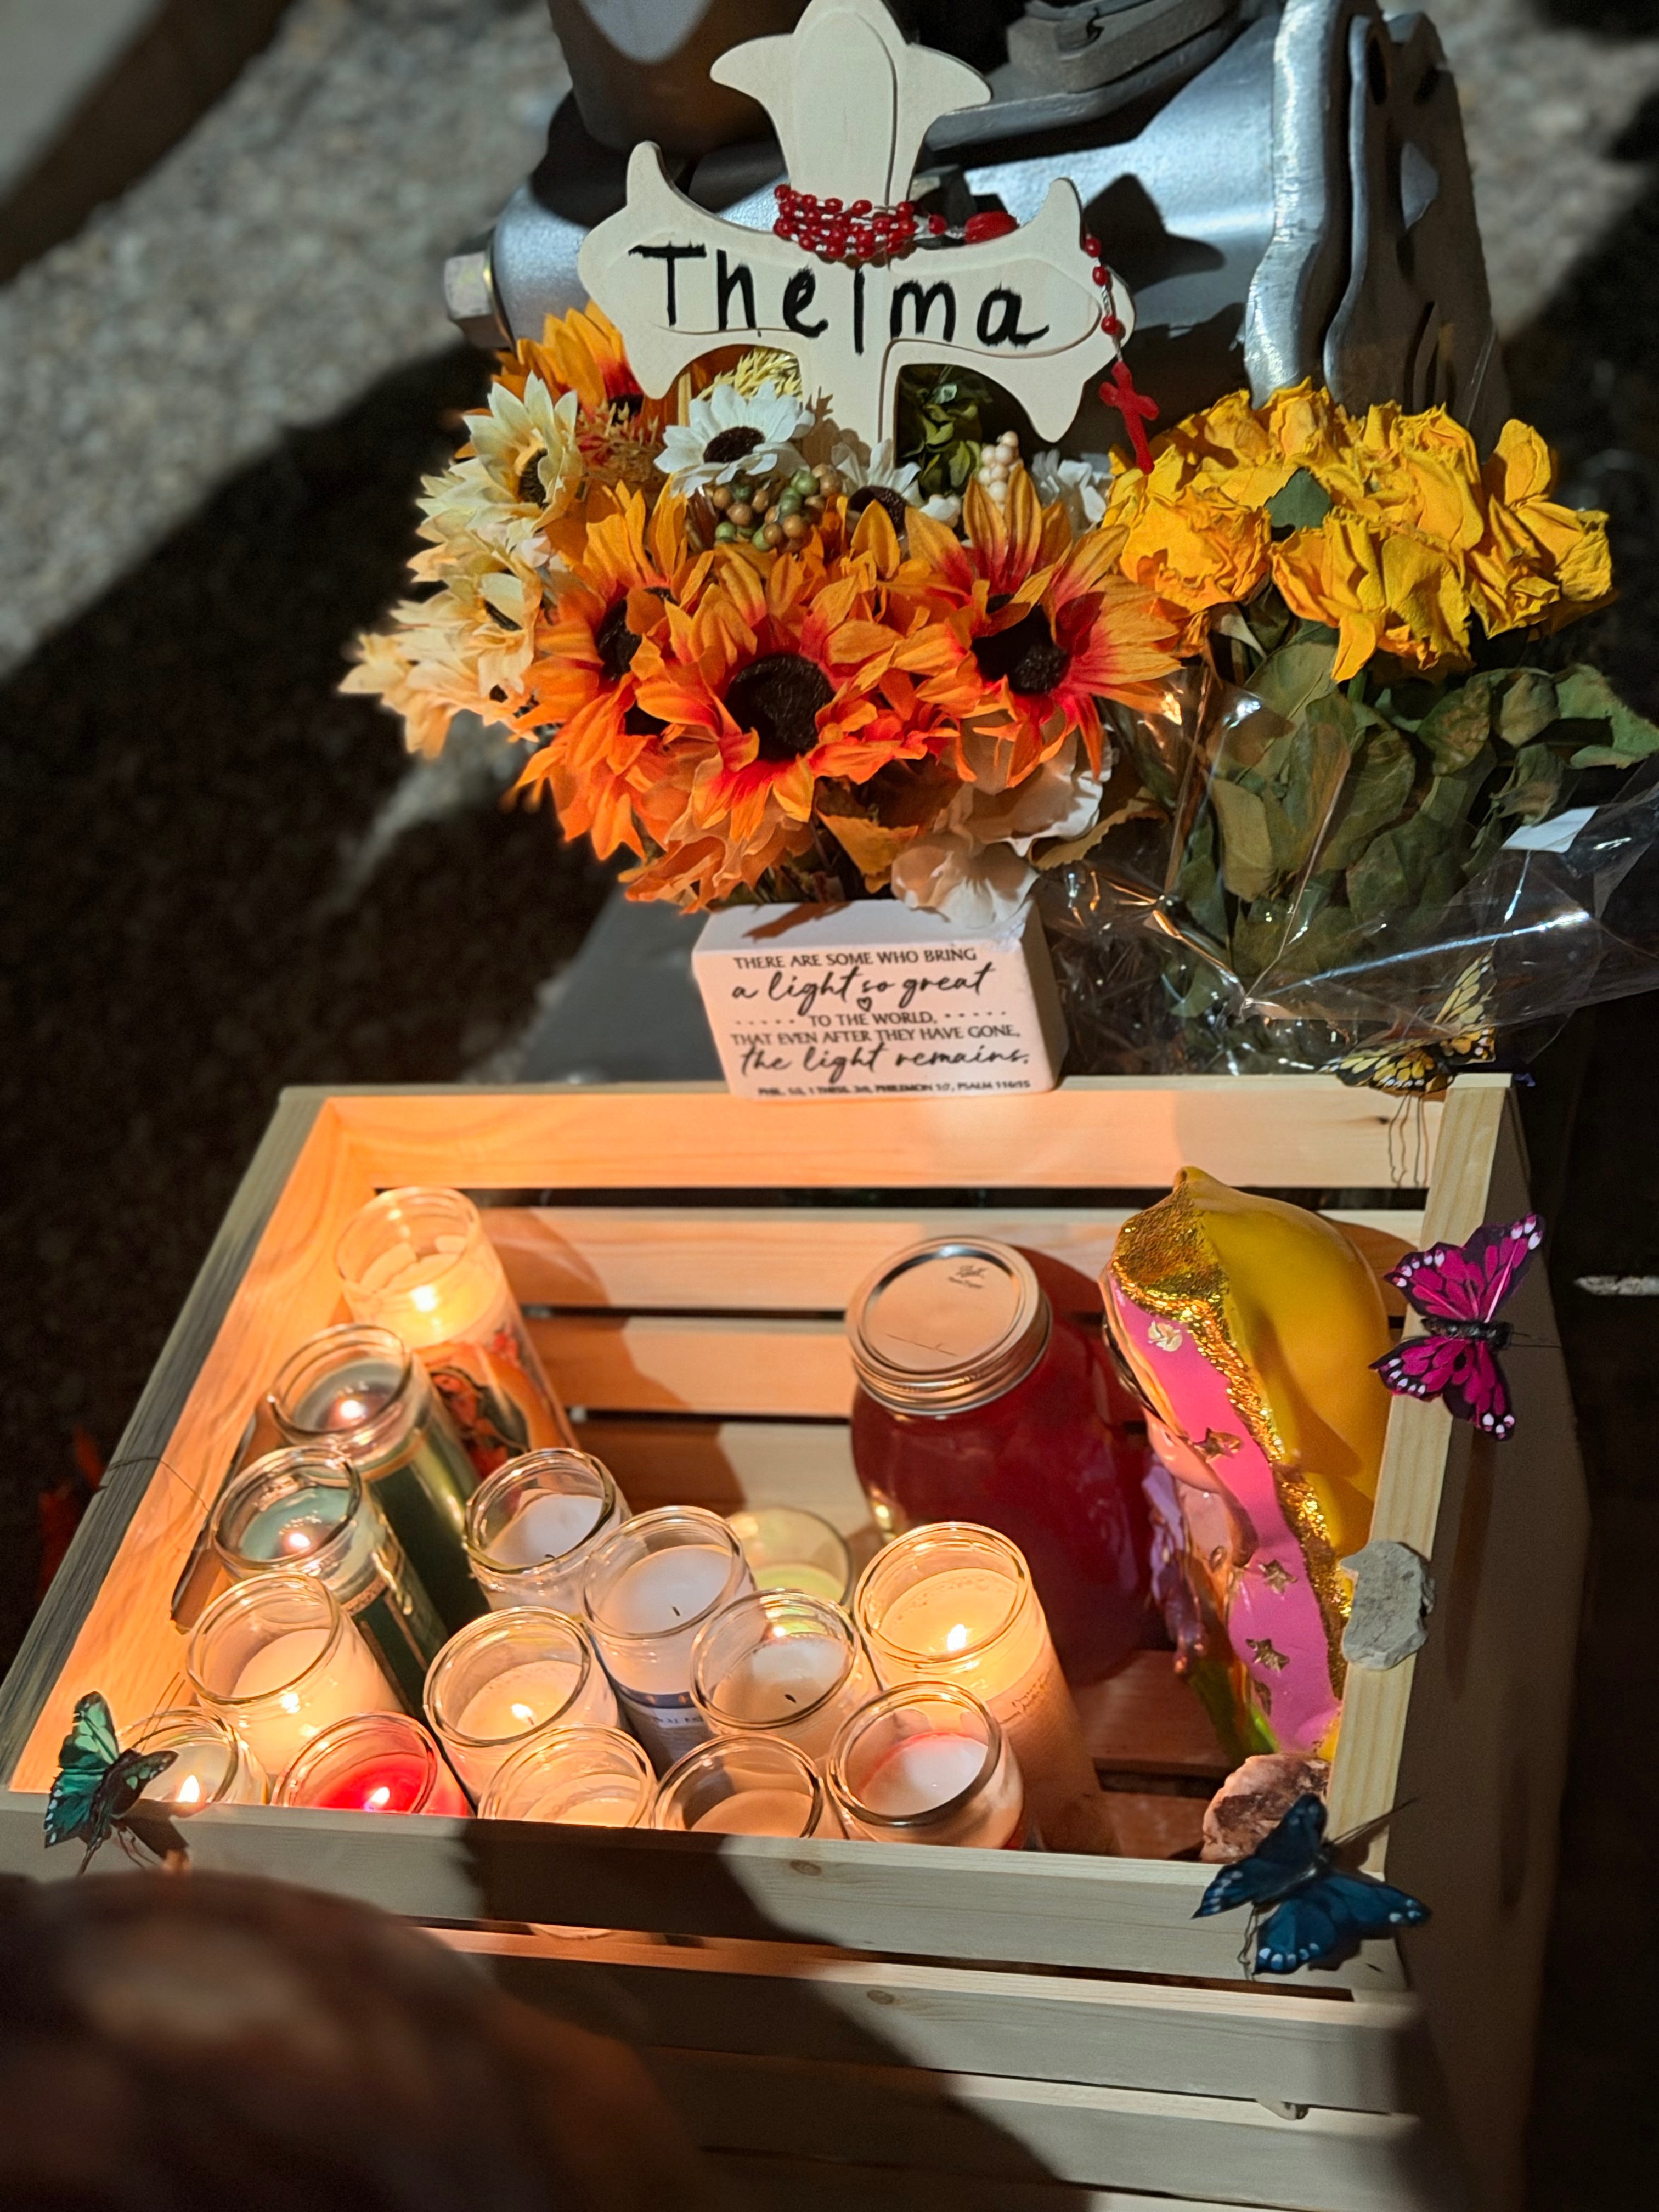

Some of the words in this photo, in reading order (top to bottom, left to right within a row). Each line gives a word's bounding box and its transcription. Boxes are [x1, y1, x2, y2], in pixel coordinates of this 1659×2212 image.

[628, 243, 1049, 354] Thelma
[733, 956, 785, 969] THERE
[791, 954, 822, 967] ARE
[826, 952, 874, 966] SOME
[877, 950, 919, 964] WHO
[923, 948, 977, 962] BRING
[732, 986, 759, 999] a
[768, 966, 863, 1017] light
[862, 980, 895, 993] so
[899, 961, 996, 1009] great
[808, 1014, 832, 1028] TO
[835, 1013, 869, 1026] THE
[730, 1033, 772, 1046] THAT
[777, 1031, 817, 1045] EVEN
[823, 1029, 872, 1043] AFTER
[875, 1028, 915, 1042] THEY
[920, 1026, 964, 1040] HAVE
[740, 1043, 793, 1077] the
[803, 1042, 889, 1084] light
[895, 1045, 1030, 1067] remains.
[957, 1082, 993, 1091] PSALM
